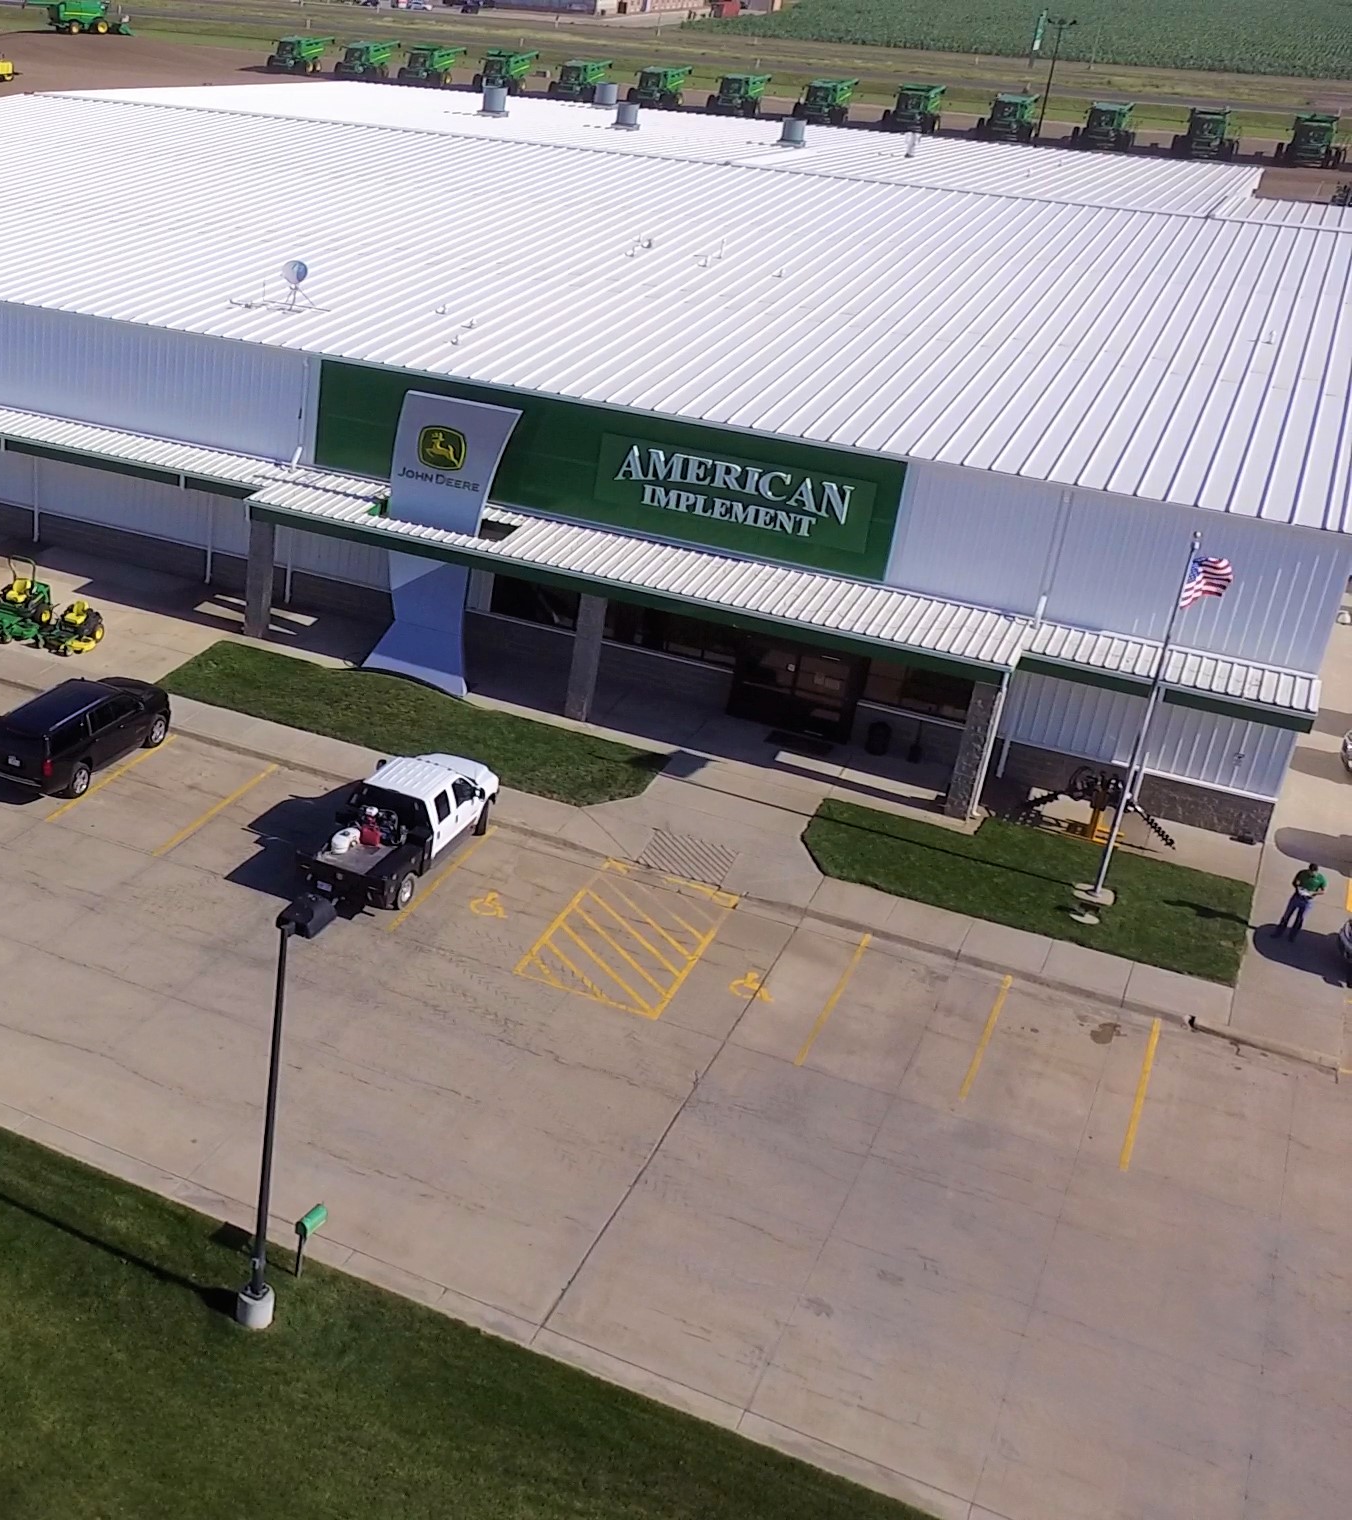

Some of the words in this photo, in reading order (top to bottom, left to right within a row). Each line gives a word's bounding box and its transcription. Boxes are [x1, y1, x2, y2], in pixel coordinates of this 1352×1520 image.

[397, 466, 434, 483] JOHN
[435, 473, 480, 492] DEERE
[614, 445, 855, 525] AMERICAN
[641, 484, 816, 537] IMPLEMENT
